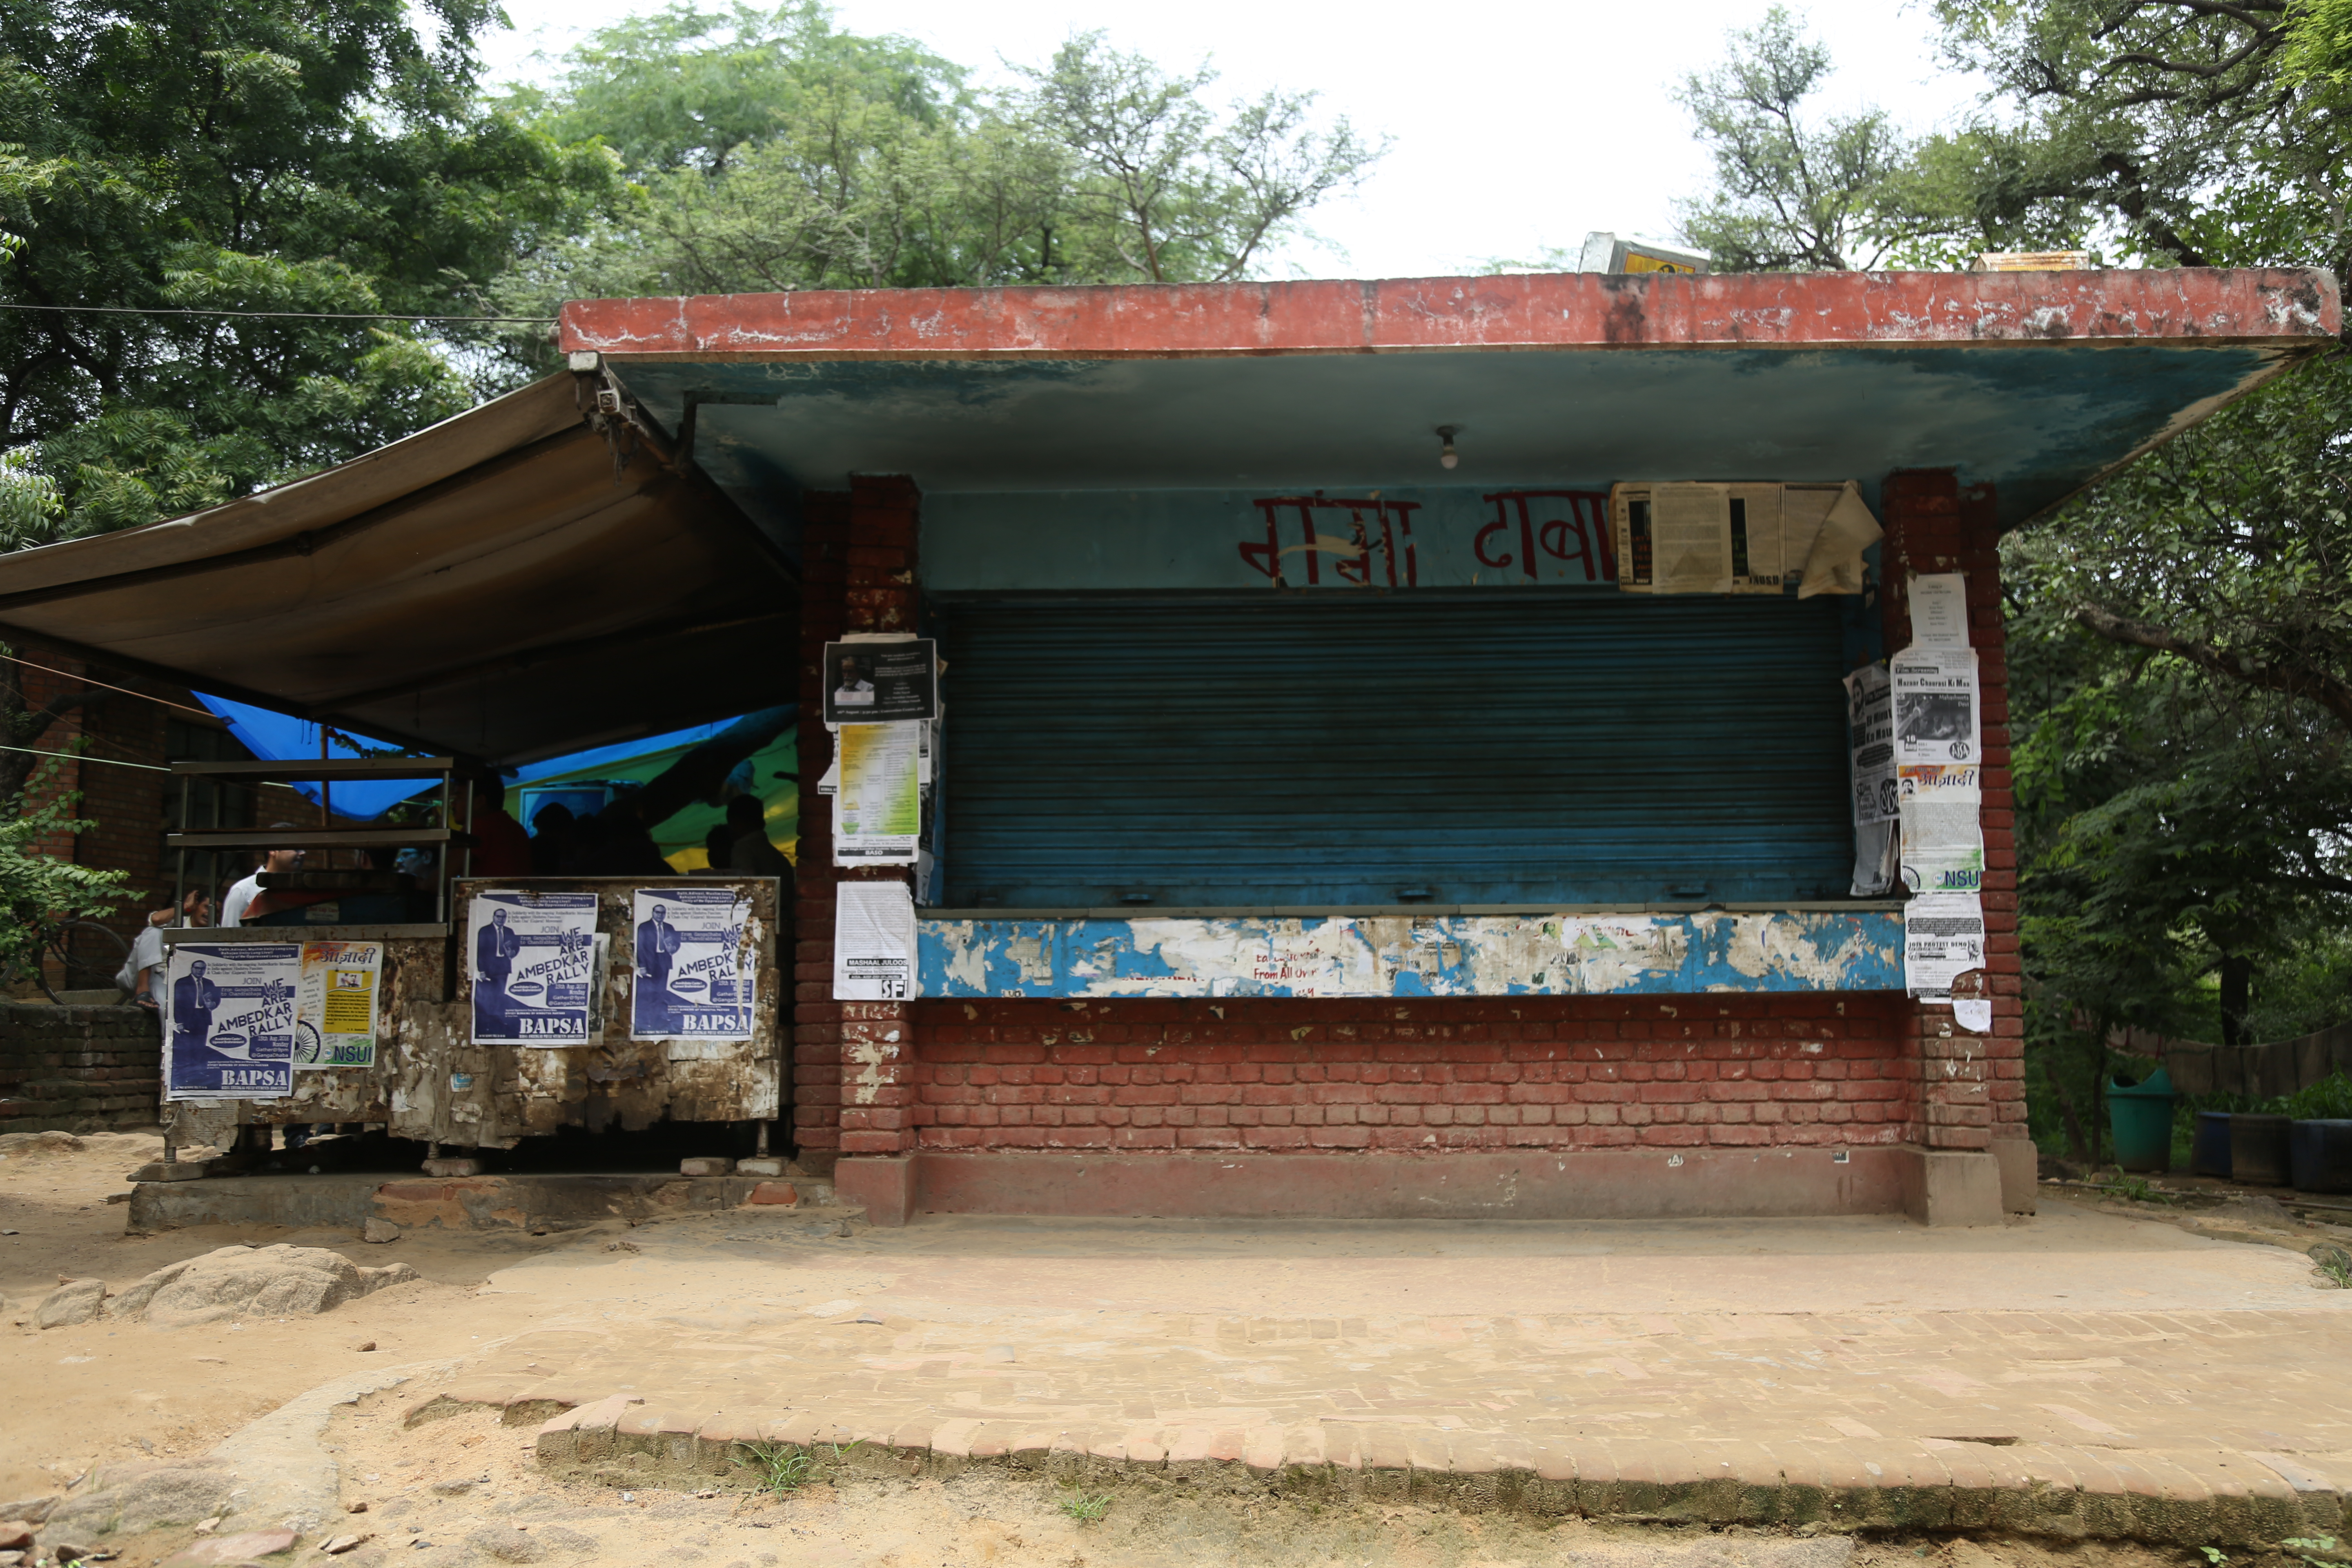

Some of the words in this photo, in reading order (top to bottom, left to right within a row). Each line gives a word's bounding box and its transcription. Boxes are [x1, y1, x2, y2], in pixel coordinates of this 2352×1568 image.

[1238, 489, 1421, 588] गंगा
[1898, 679, 1918, 687] Hazaar
[1920, 678, 1946, 687] Chaurasi
[1948, 679, 1954, 687] Ki
[1957, 679, 1969, 687] Maa
[1873, 708, 1892, 723] Minut
[1876, 728, 1892, 741] Mau
[1919, 770, 1974, 787] आज़ादी
[562, 927, 583, 943] WE
[724, 923, 742, 939] WE
[560, 937, 584, 956] ARE
[722, 938, 740, 952] AR
[320, 948, 376, 964] आज़ादी
[679, 950, 752, 977] AMBEDK
[517, 951, 588, 981] AMBEDKAR
[546, 962, 589, 985] RALLY
[709, 959, 753, 981] RALY
[1254, 968, 1278, 979] From
[1281, 967, 1292, 979] All
[264, 978, 286, 994] WE
[262, 990, 287, 1008] ARE
[218, 1002, 292, 1033] AMBEDKAR
[682, 1015, 749, 1030] BAPSA
[248, 1014, 293, 1038] RALLY
[519, 1018, 584, 1034] BAPSA
[334, 1046, 372, 1062] NSUI
[221, 1070, 287, 1086] BAPSA
